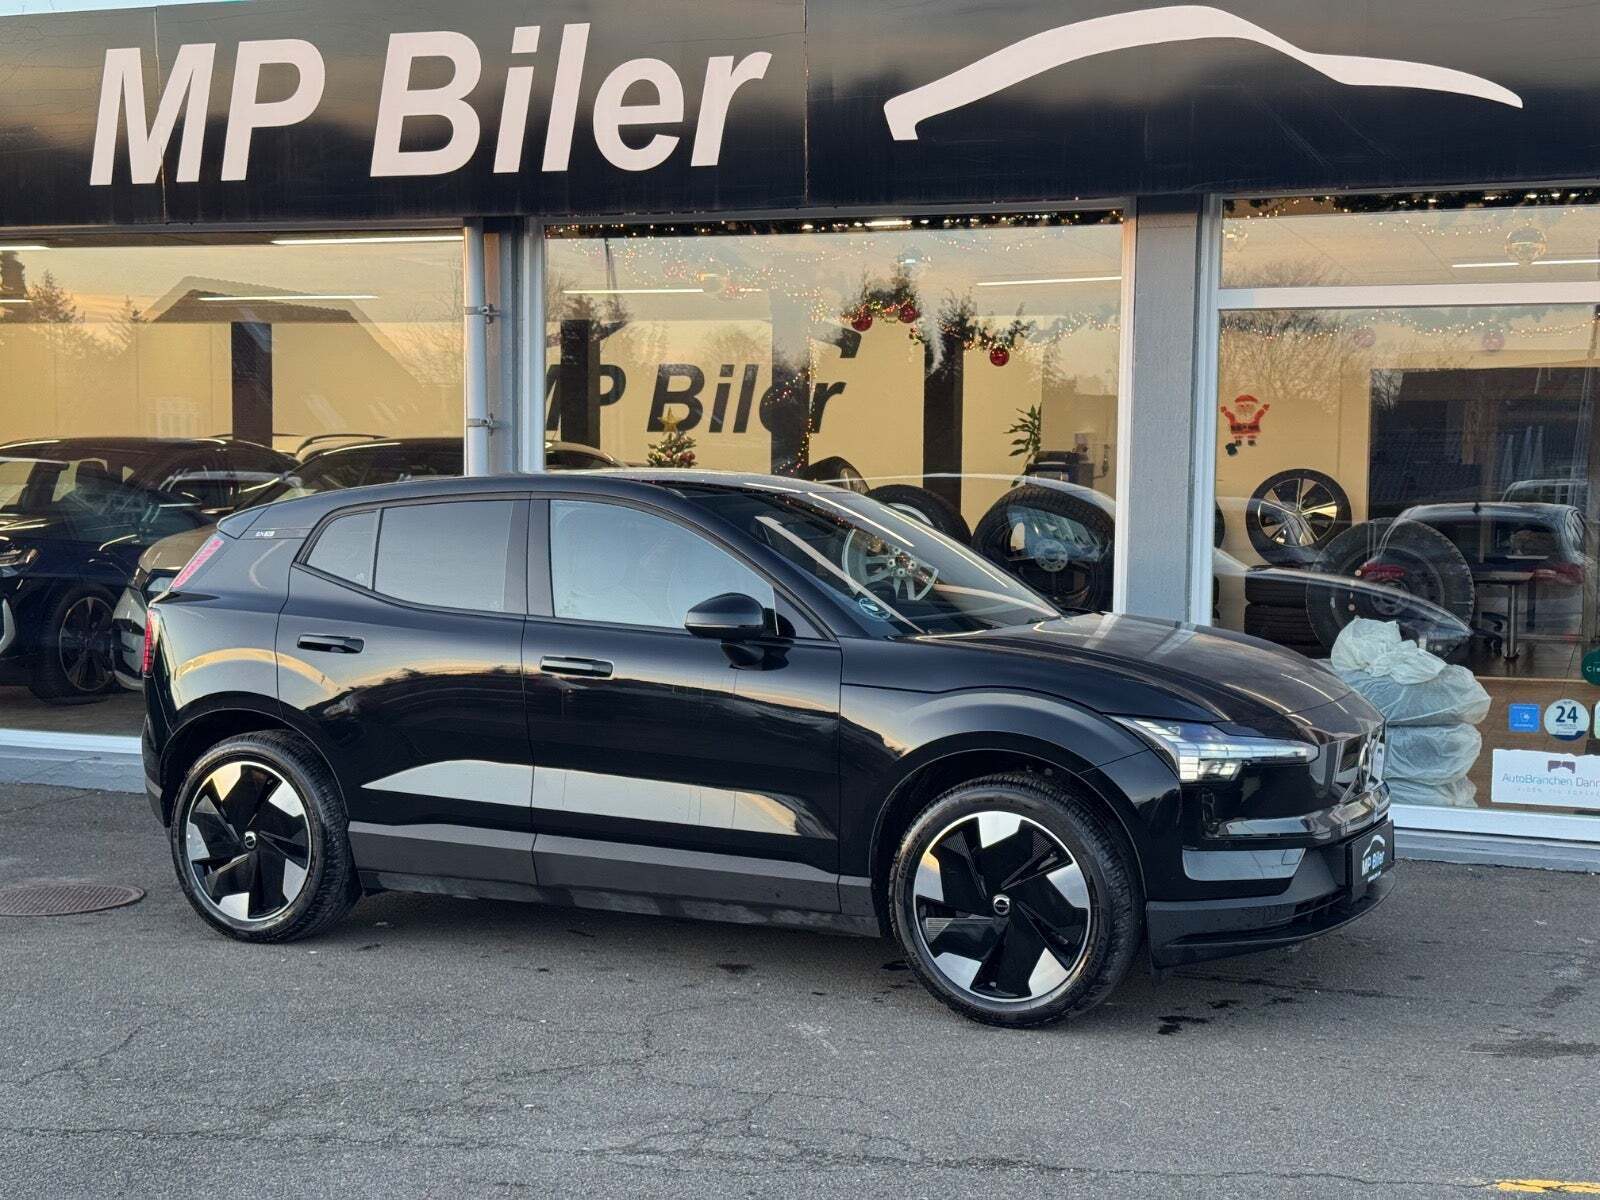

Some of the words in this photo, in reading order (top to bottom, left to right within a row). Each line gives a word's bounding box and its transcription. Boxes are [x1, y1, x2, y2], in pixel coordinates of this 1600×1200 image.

[90, 39, 325, 186] MP
[370, 22, 772, 177] Biler
[1555, 705, 1579, 723] 24
[1502, 773, 1573, 786] AutoBranchen
